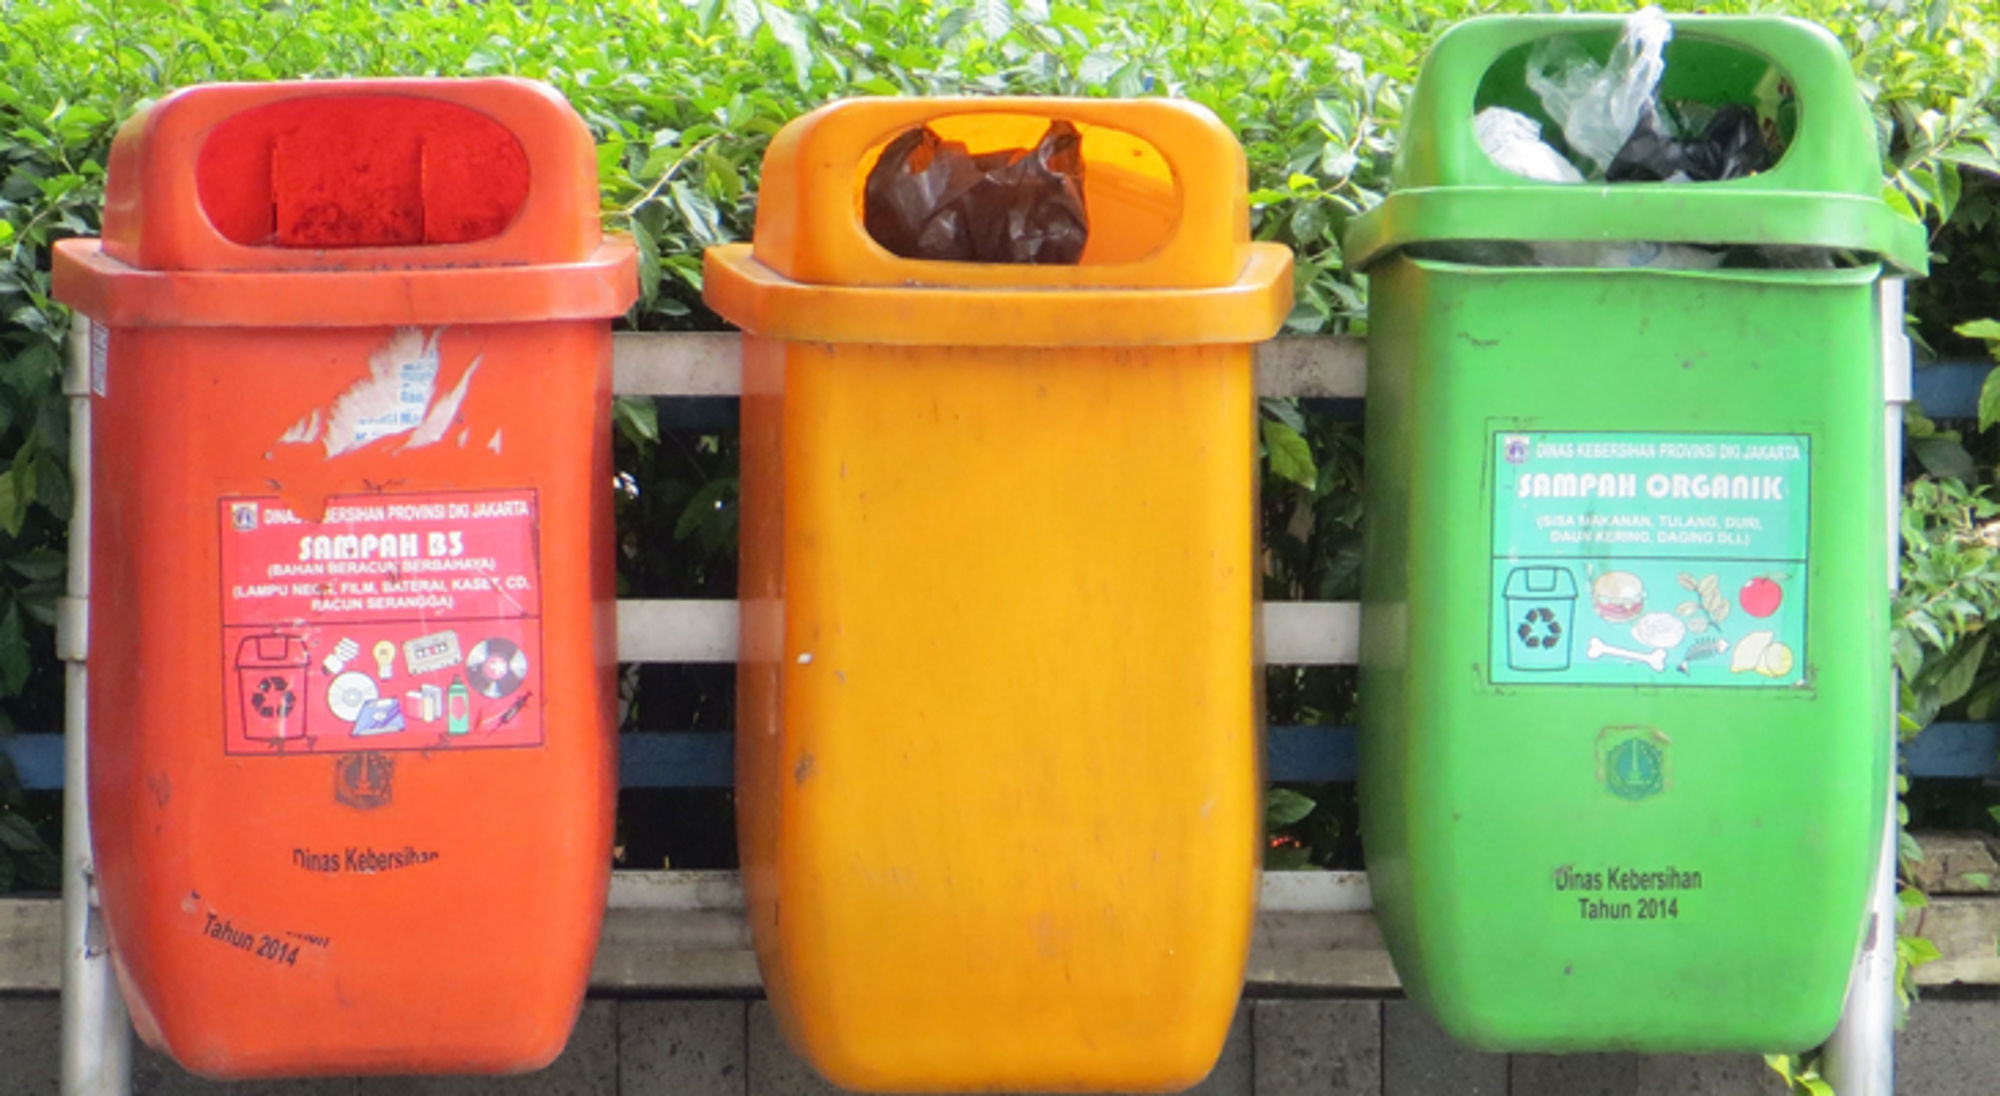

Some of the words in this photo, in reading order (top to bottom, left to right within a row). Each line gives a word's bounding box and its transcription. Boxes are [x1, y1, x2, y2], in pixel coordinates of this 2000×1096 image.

[1537, 443, 1573, 458] DINAS
[1578, 443, 1655, 458] KEBERSIHAN
[1660, 443, 1715, 459] PROVINSI
[1720, 444, 1740, 459] DKI
[1744, 445, 1799, 460] JAKARTA
[1518, 473, 1635, 497] SAMPAH
[1646, 474, 1783, 500] ORGANIK
[389, 504, 445, 520] PROVINSI
[449, 503, 469, 518] DKI
[473, 501, 529, 518] JAKARTA
[299, 534, 418, 560] SAMPAH
[429, 532, 463, 556] B3
[1658, 532, 1713, 544] DAGING
[268, 564, 323, 578] (BAHAN
[403, 558, 496, 572] BERBAHAYA)
[233, 586, 287, 599] (LAMPU
[312, 598, 362, 611] RACUN
[367, 595, 454, 610] SERANGGA)
[1556, 868, 1602, 889] Dinas
[1607, 867, 1701, 890] Kebersihan
[1578, 898, 1631, 919] Tahun
[1637, 898, 1678, 918] 2014
[204, 912, 254, 952] Tahun
[256, 935, 299, 967] 2014
